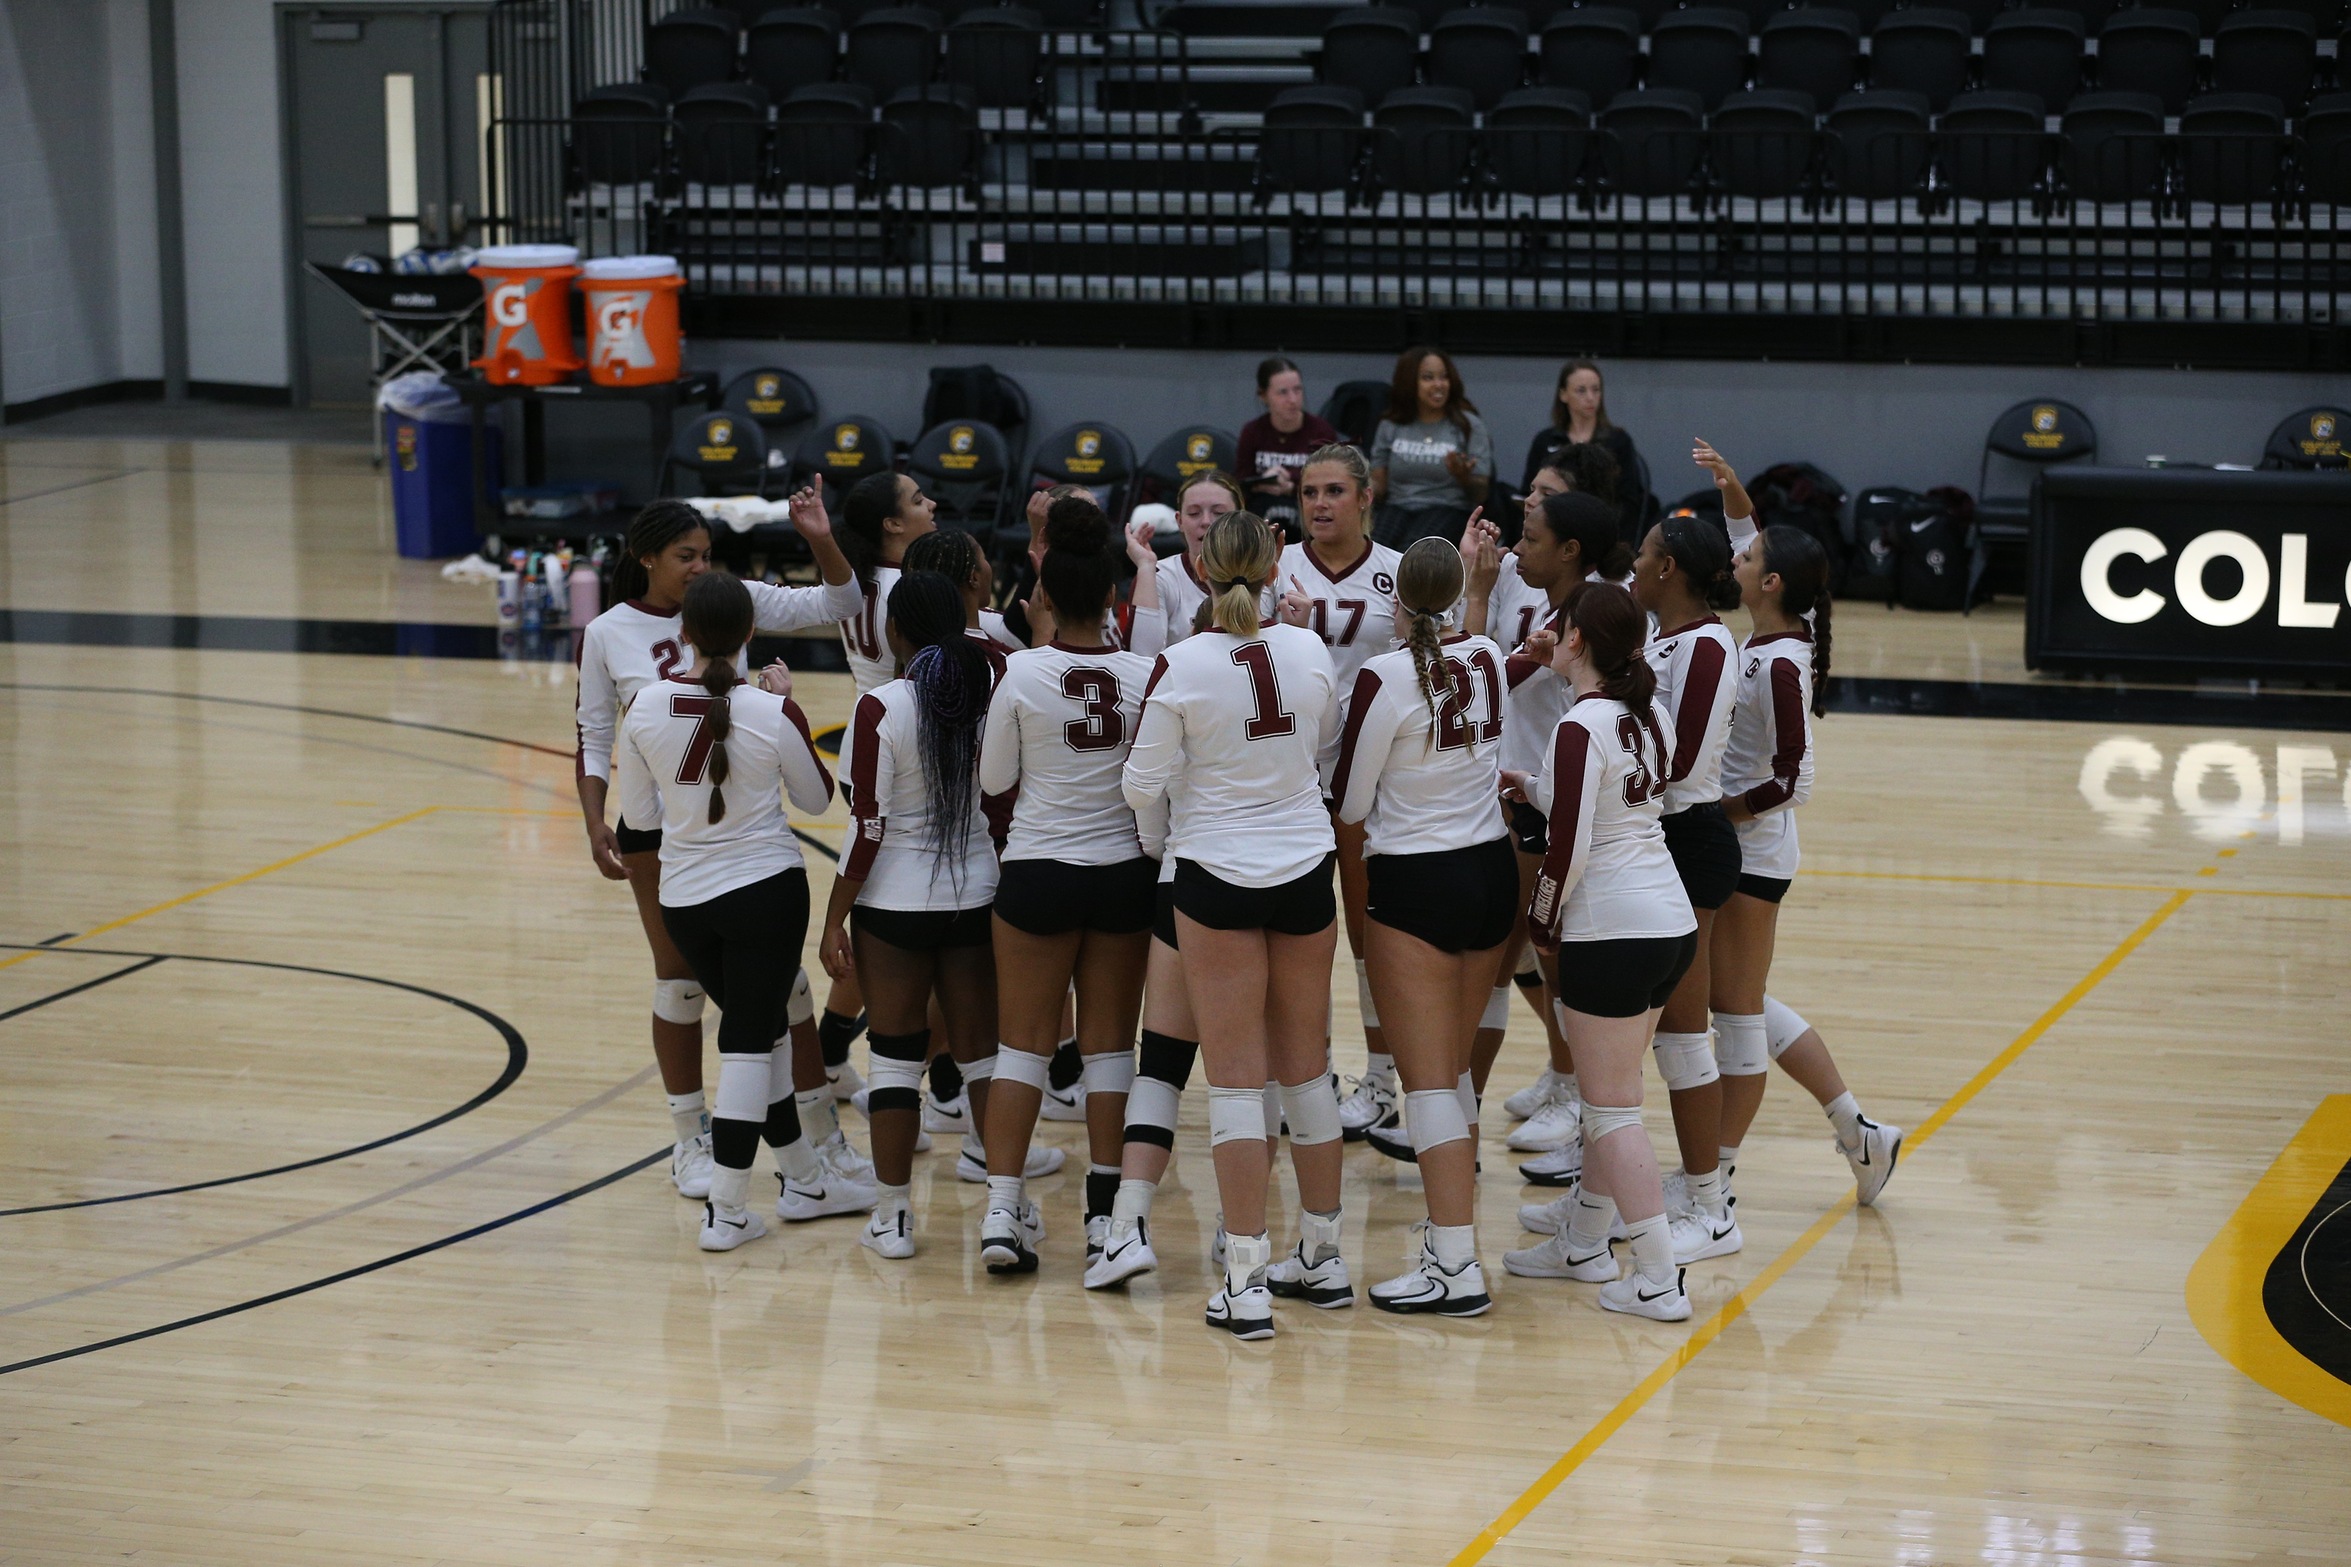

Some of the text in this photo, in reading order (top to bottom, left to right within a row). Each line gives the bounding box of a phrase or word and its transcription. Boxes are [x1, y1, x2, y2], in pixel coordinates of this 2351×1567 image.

[493, 285, 527, 327] G
[601, 301, 632, 338] G
[2081, 527, 2351, 628] COL
[650, 633, 690, 681] 2
[1311, 598, 1367, 647] 17
[1060, 666, 1126, 753] 3
[1230, 640, 1296, 741] 1
[1427, 648, 1504, 752] 21
[670, 693, 731, 785] 7
[1615, 706, 1670, 808] 31
